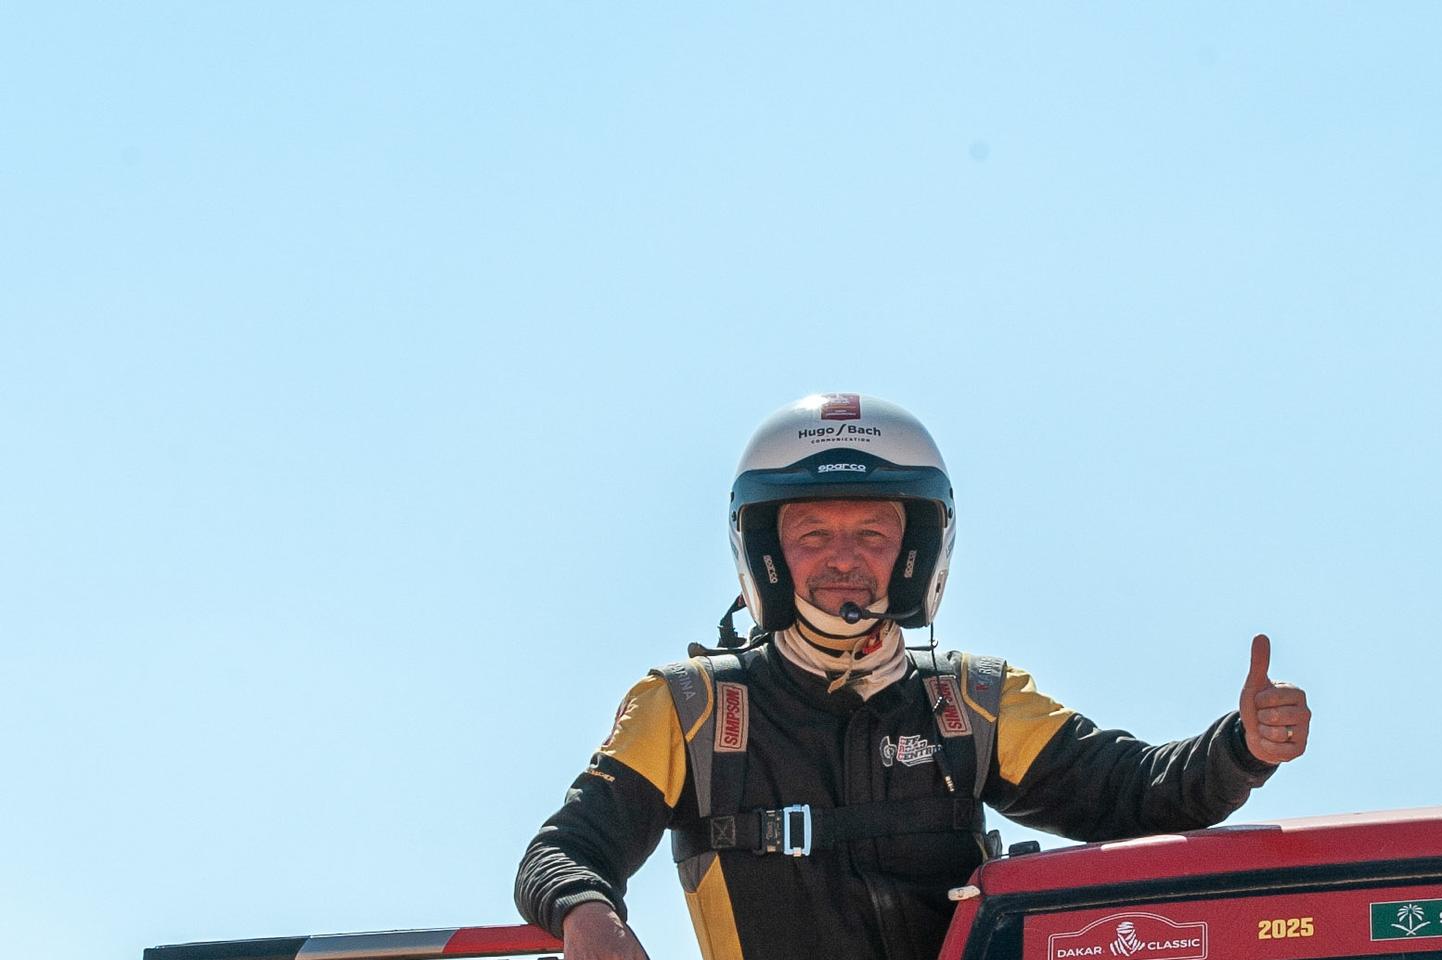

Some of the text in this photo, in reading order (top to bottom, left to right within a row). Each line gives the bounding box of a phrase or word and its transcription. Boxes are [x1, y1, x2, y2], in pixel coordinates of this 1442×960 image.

[798, 426, 835, 439] Hugo
[847, 425, 881, 437] Bach
[818, 463, 866, 473] sparco
[724, 687, 740, 746] SIMPSON
[939, 682, 963, 730] SIMSON
[1258, 917, 1314, 940] 2025
[1057, 938, 1201, 958] DAKAR CLASSIC
